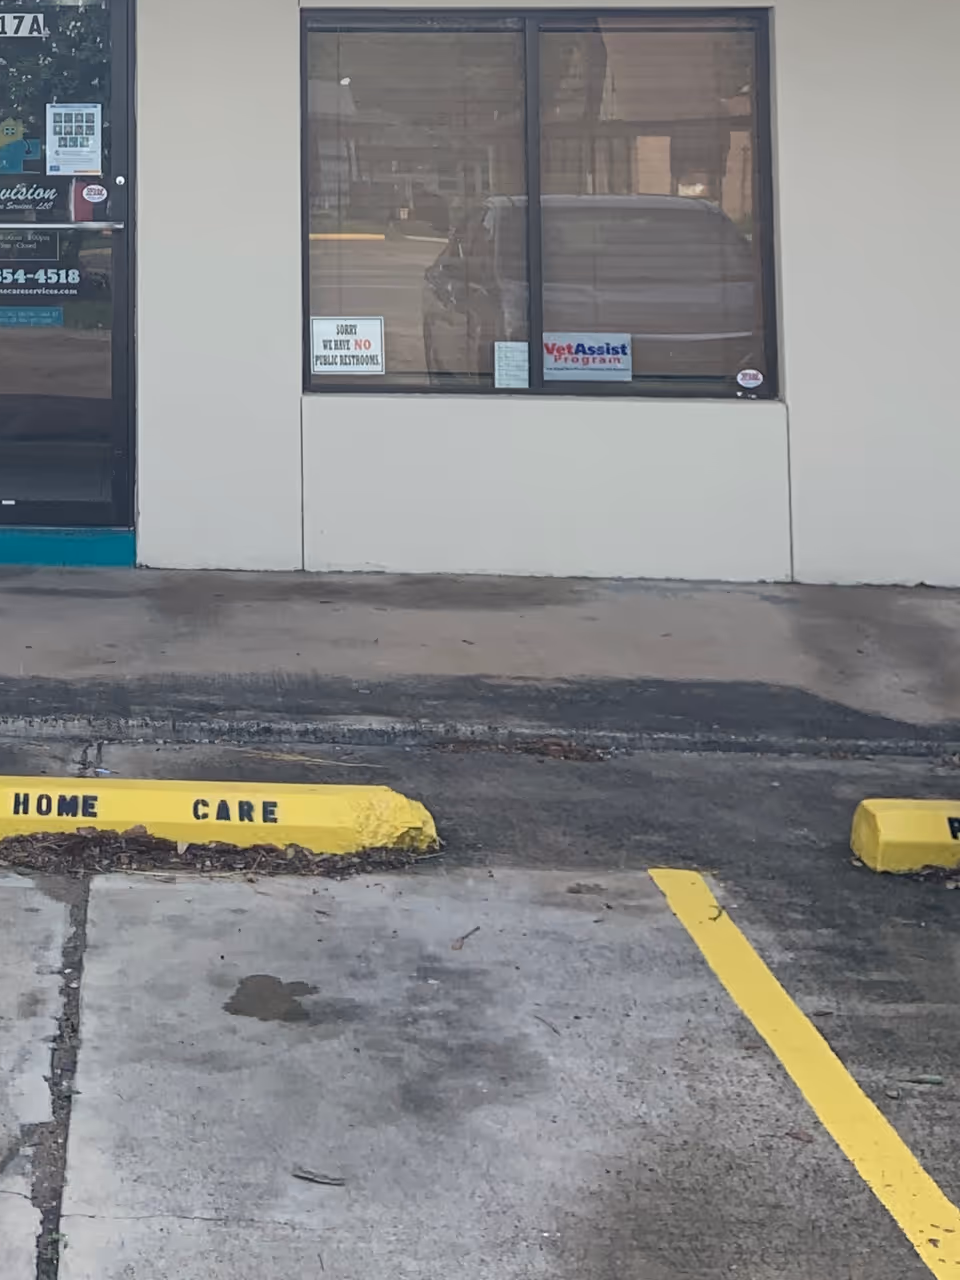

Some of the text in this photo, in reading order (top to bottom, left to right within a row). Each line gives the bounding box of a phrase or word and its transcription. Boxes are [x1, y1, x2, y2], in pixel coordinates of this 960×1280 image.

[35, 201, 54, 210] LLC
[336, 324, 358, 335] SORRY
[322, 339, 372, 350] WE HAVE NO
[544, 343, 628, 355] VetAssist
[315, 354, 338, 366] PUBLIC
[554, 355, 621, 365] Program
[13, 792, 98, 818] HOME
[192, 798, 279, 823] CARE
